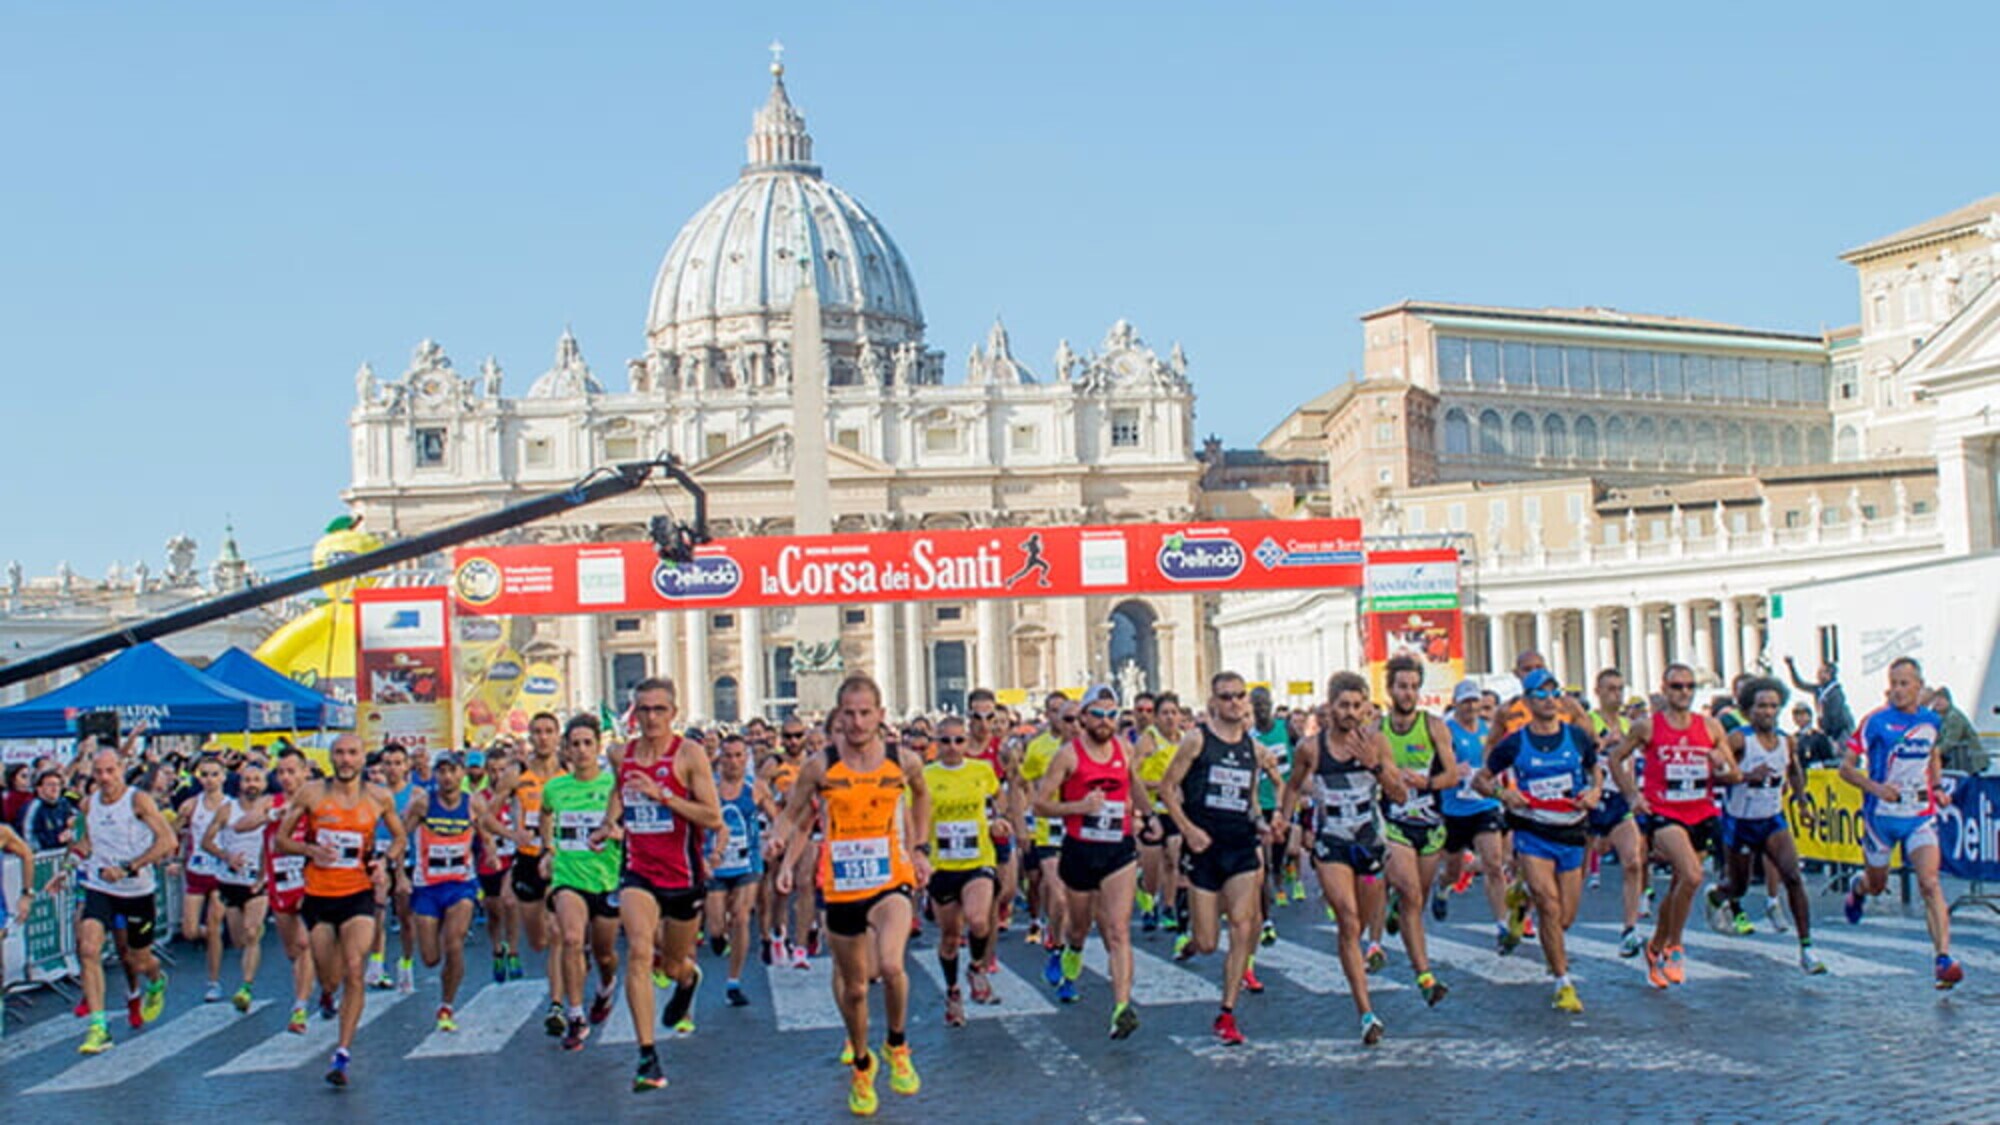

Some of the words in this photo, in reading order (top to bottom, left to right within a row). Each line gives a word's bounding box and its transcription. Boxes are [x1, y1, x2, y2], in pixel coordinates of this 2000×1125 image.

[760, 566, 778, 594] la
[778, 545, 878, 596] Corsa
[880, 561, 910, 590] dei
[913, 539, 1001, 591] Santi
[1163, 546, 1239, 568] Melinda
[658, 563, 736, 589] Melinda
